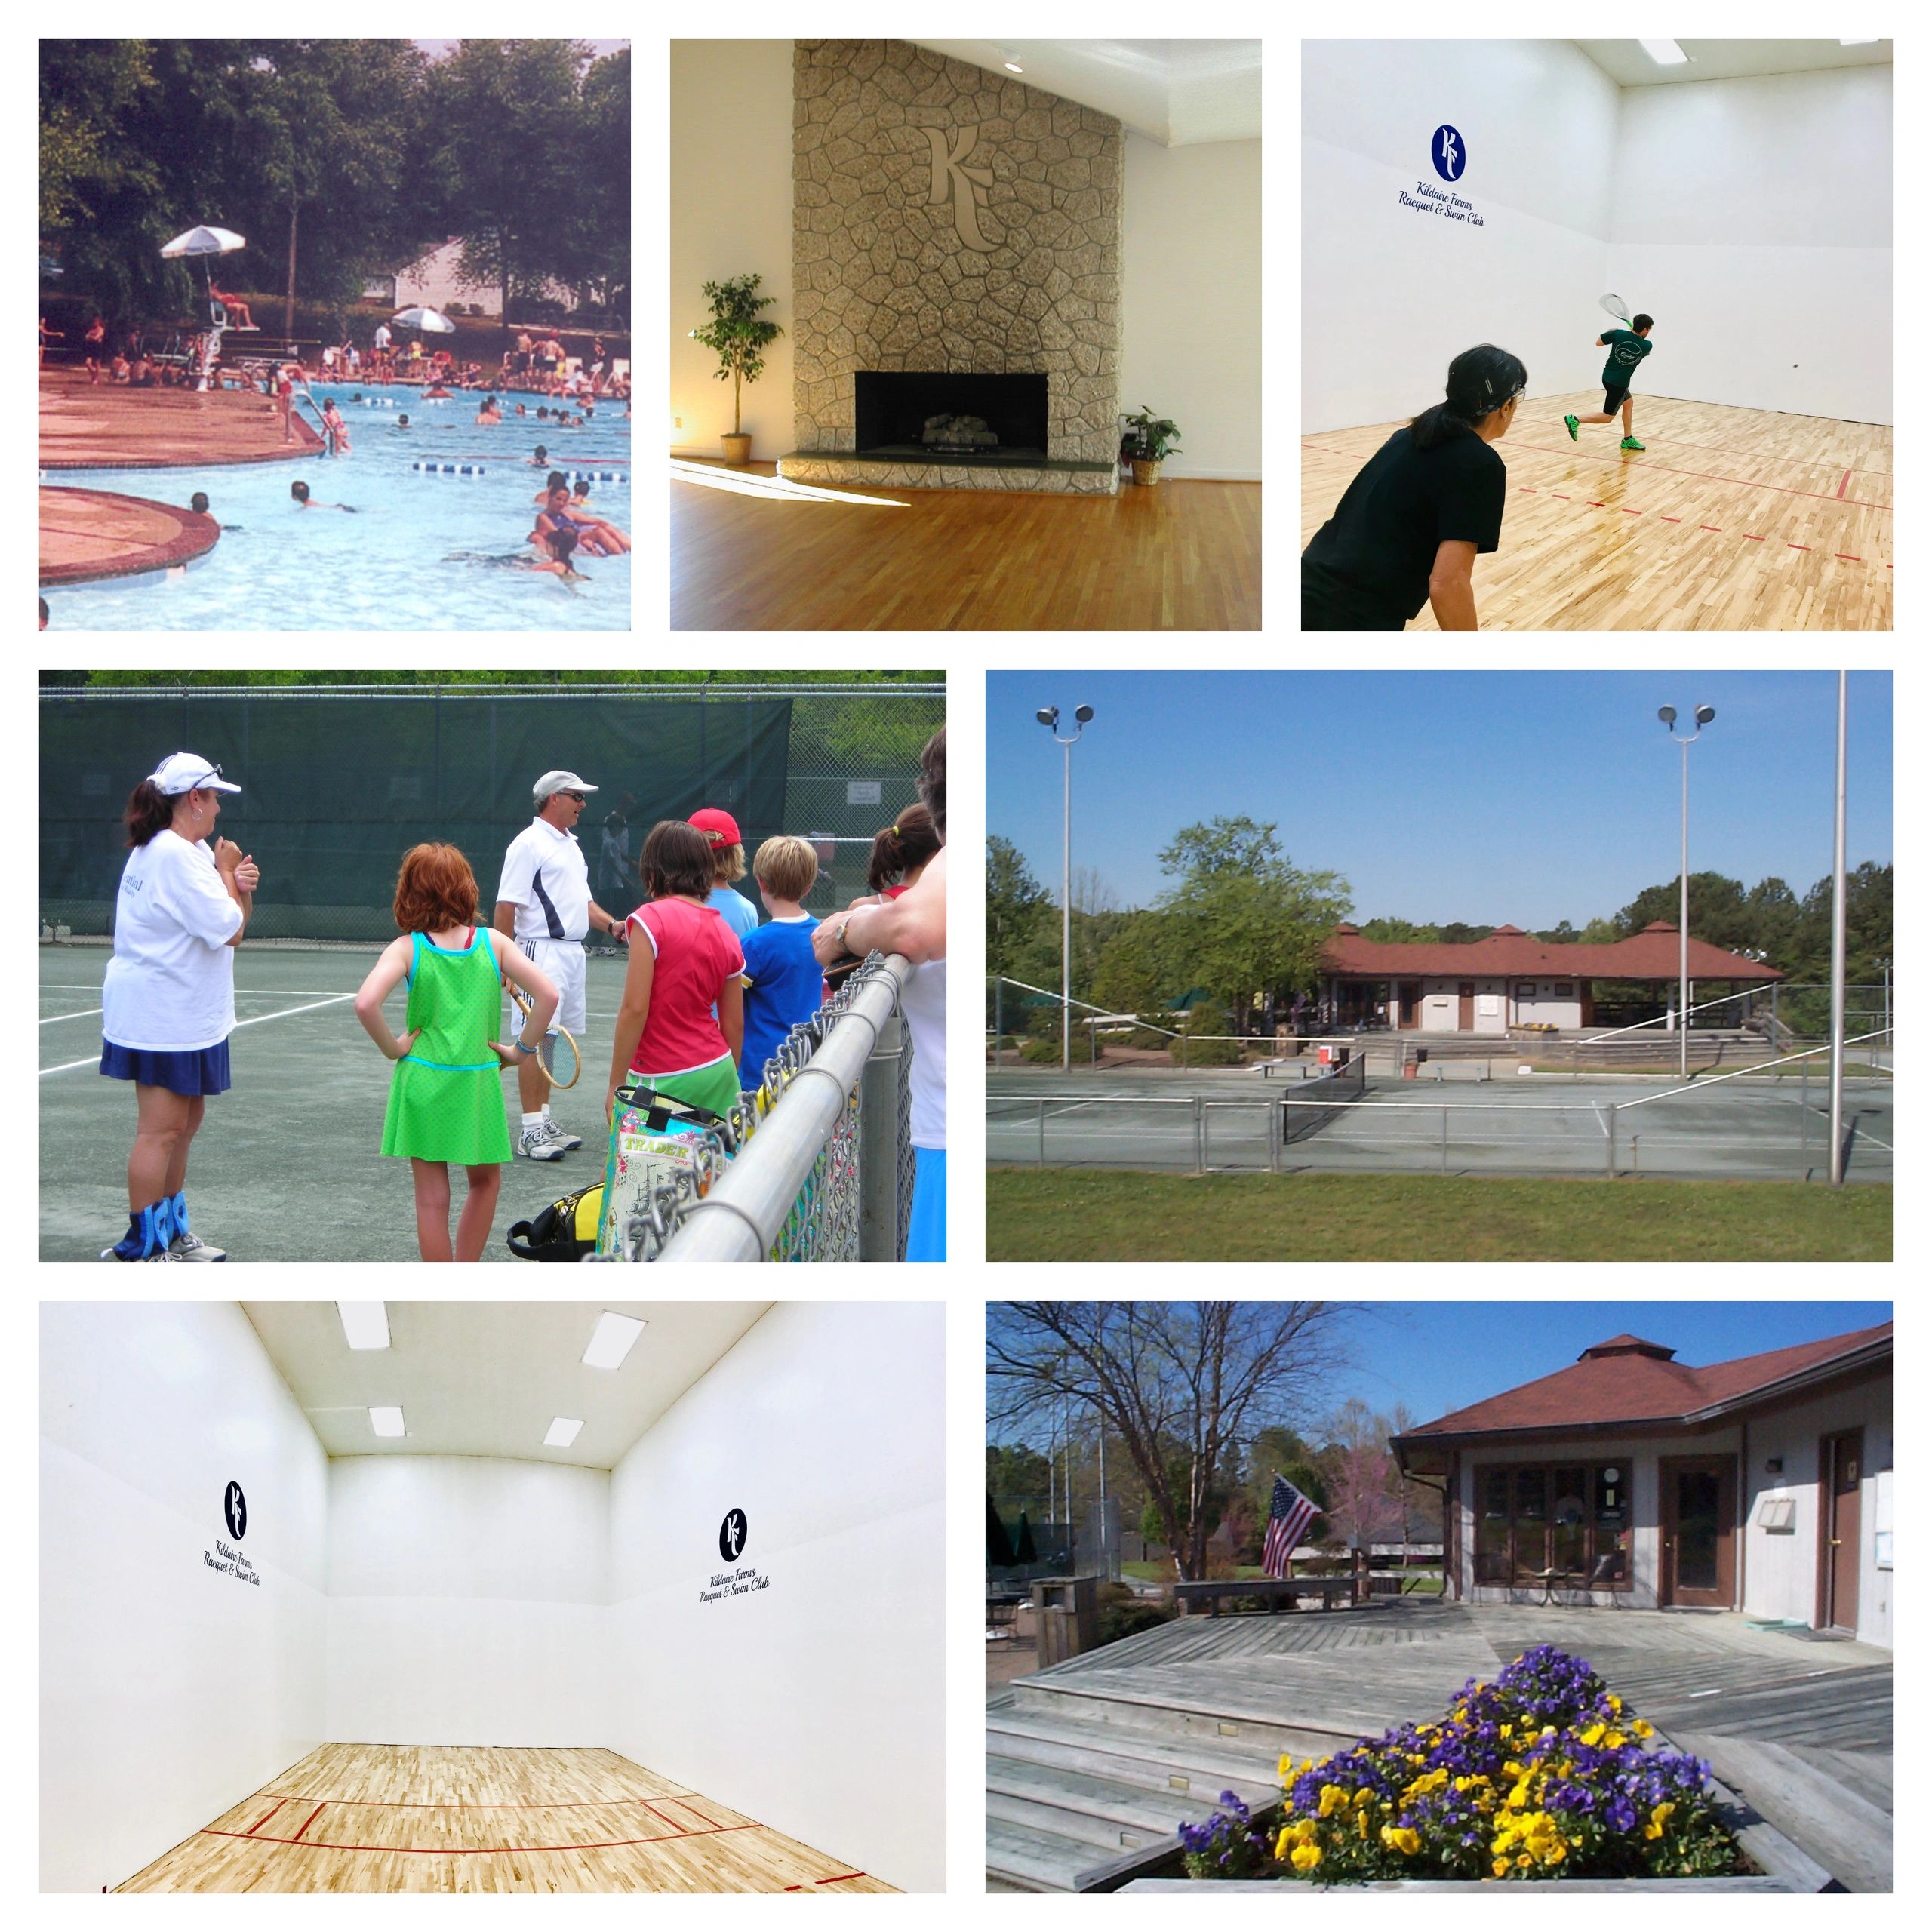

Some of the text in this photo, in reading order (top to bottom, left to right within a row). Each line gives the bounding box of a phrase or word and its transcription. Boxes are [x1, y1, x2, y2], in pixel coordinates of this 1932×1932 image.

[1398, 190, 1484, 226] Racquet & Swim Club
[1417, 181, 1472, 211] Kildaire Farms
[624, 1137, 688, 1159] TRADER
[204, 1550, 260, 1586] Racquet & Swim Club
[216, 1540, 252, 1570] Kildaire Farms
[700, 1576, 770, 1604] Racquet & Swim Club
[710, 1568, 756, 1588] Kildaire Farms
